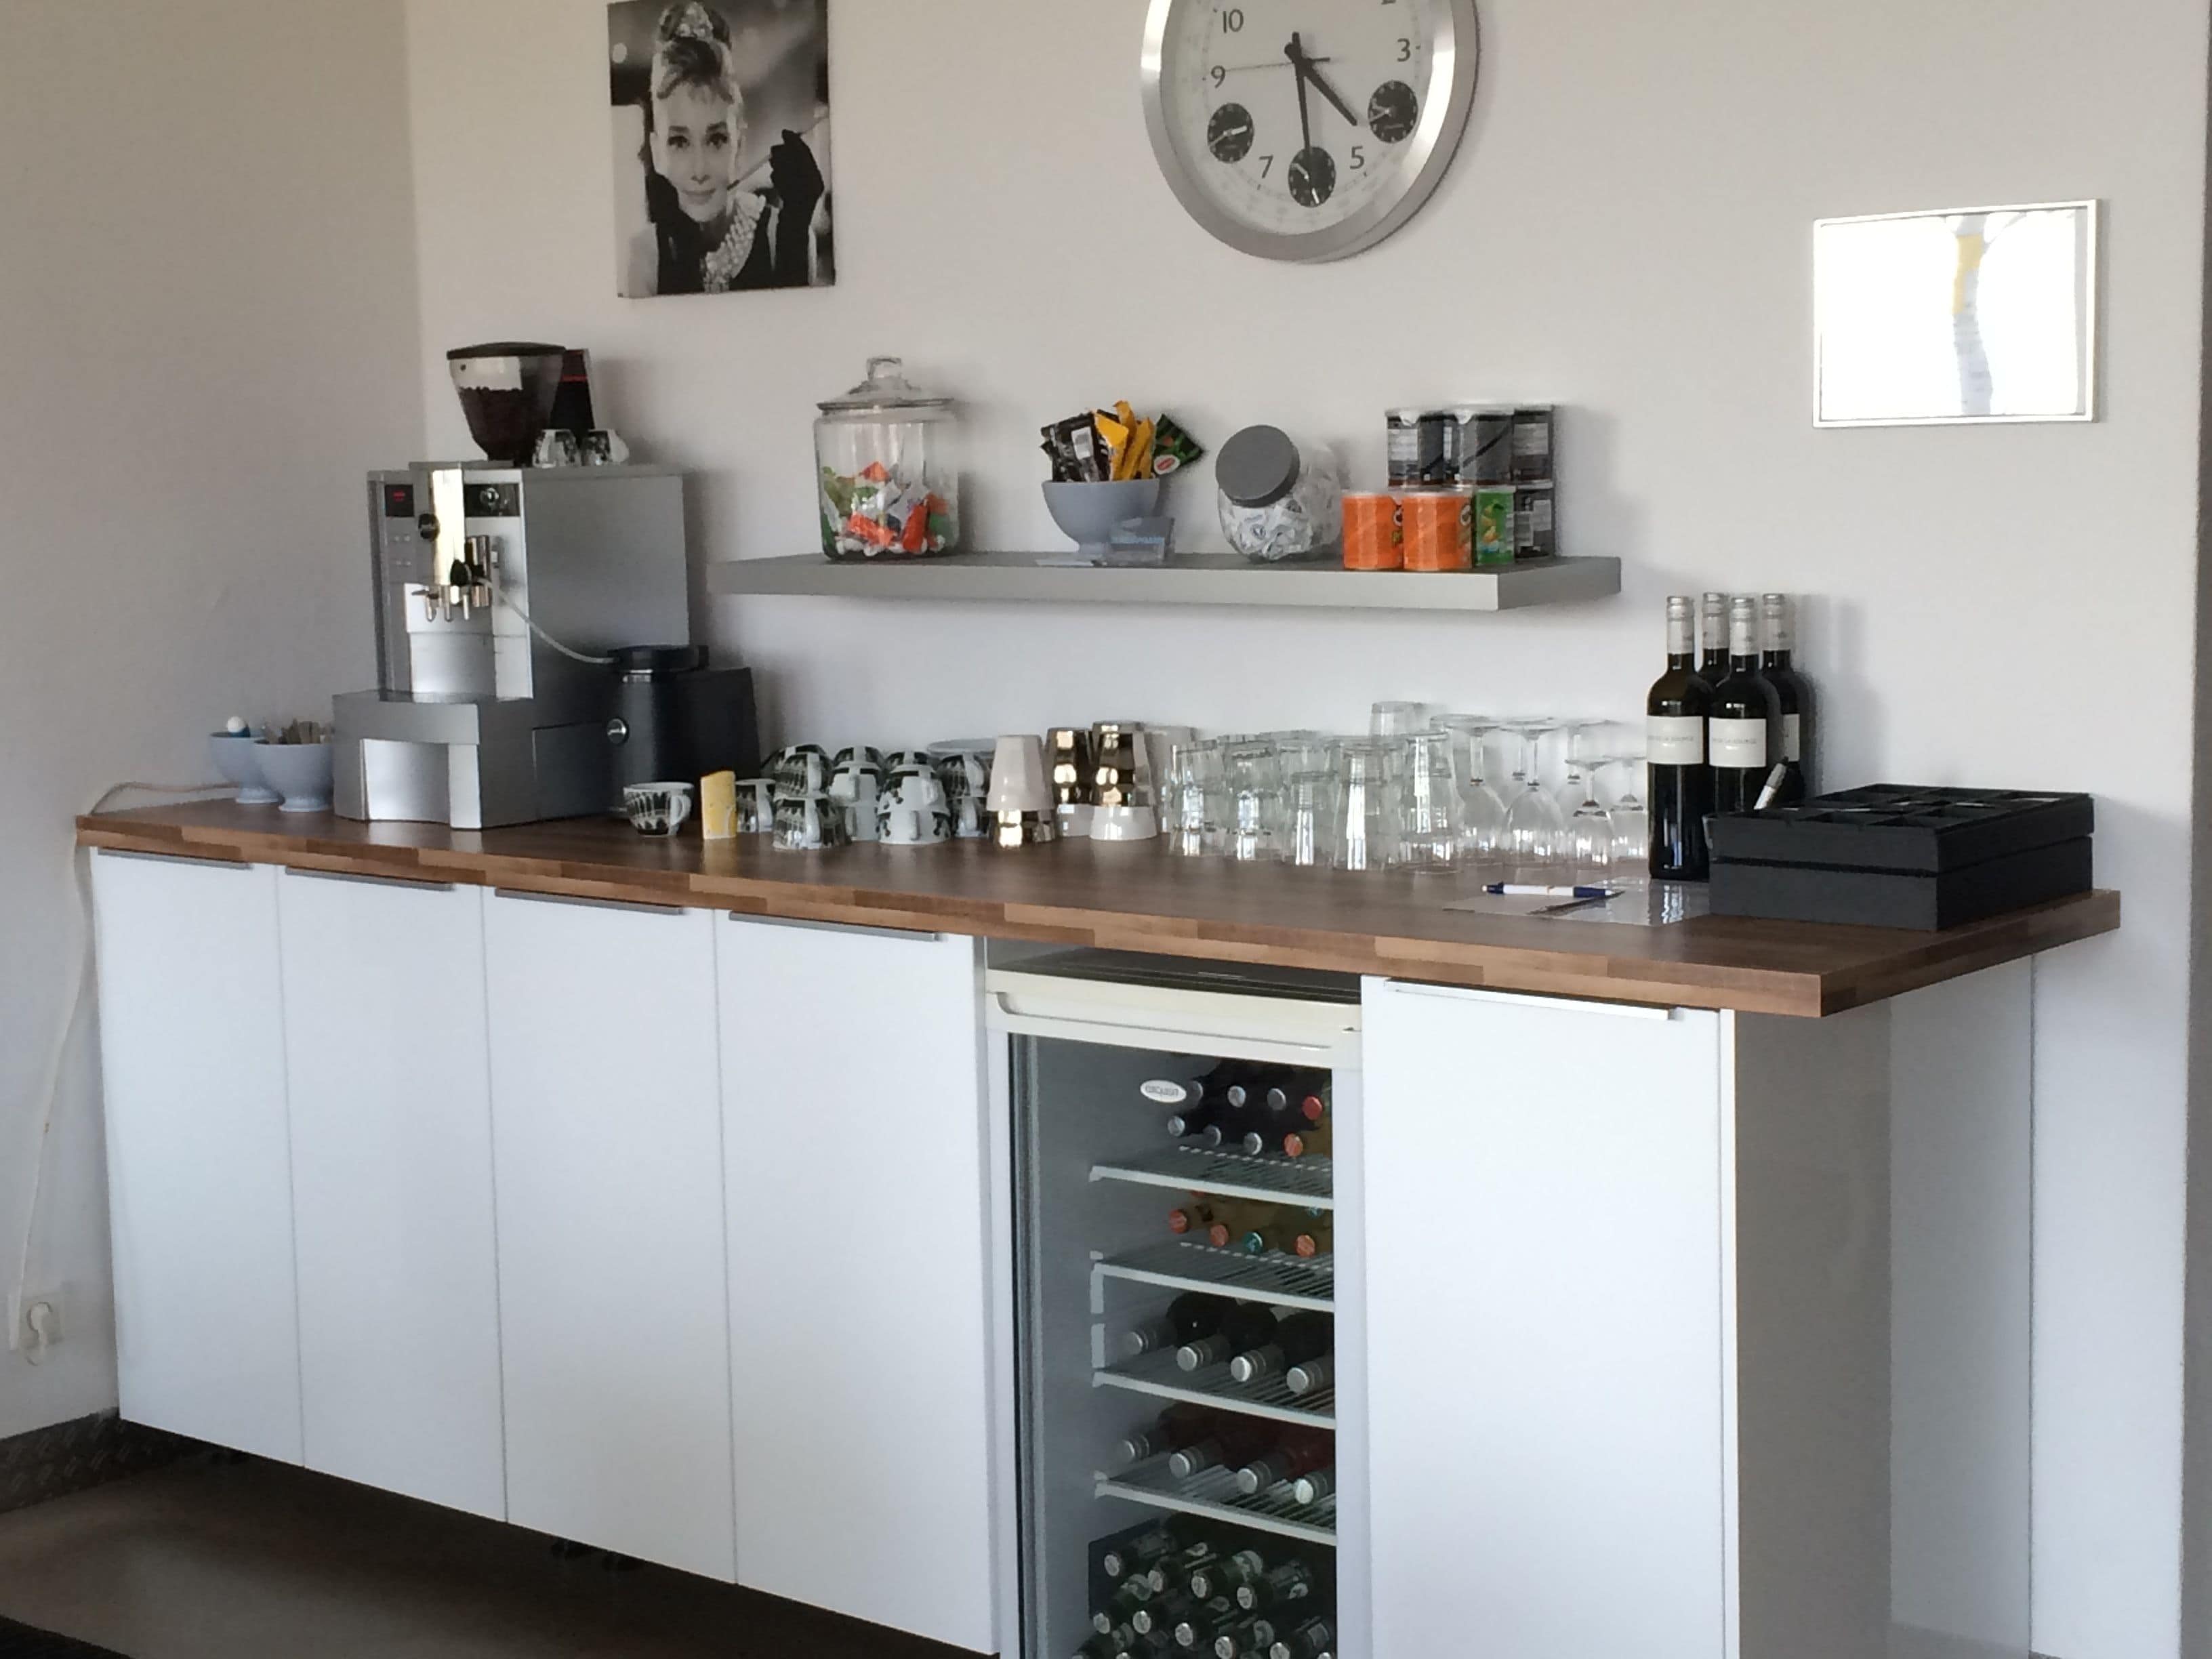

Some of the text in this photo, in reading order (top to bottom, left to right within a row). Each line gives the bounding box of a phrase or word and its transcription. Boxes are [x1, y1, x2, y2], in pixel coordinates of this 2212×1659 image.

[1223, 9, 1244, 33] 10
[1397, 38, 1411, 62] 3
[1211, 65, 1225, 89] 9
[1258, 155, 1273, 179] 7
[1350, 146, 1365, 169] 5
